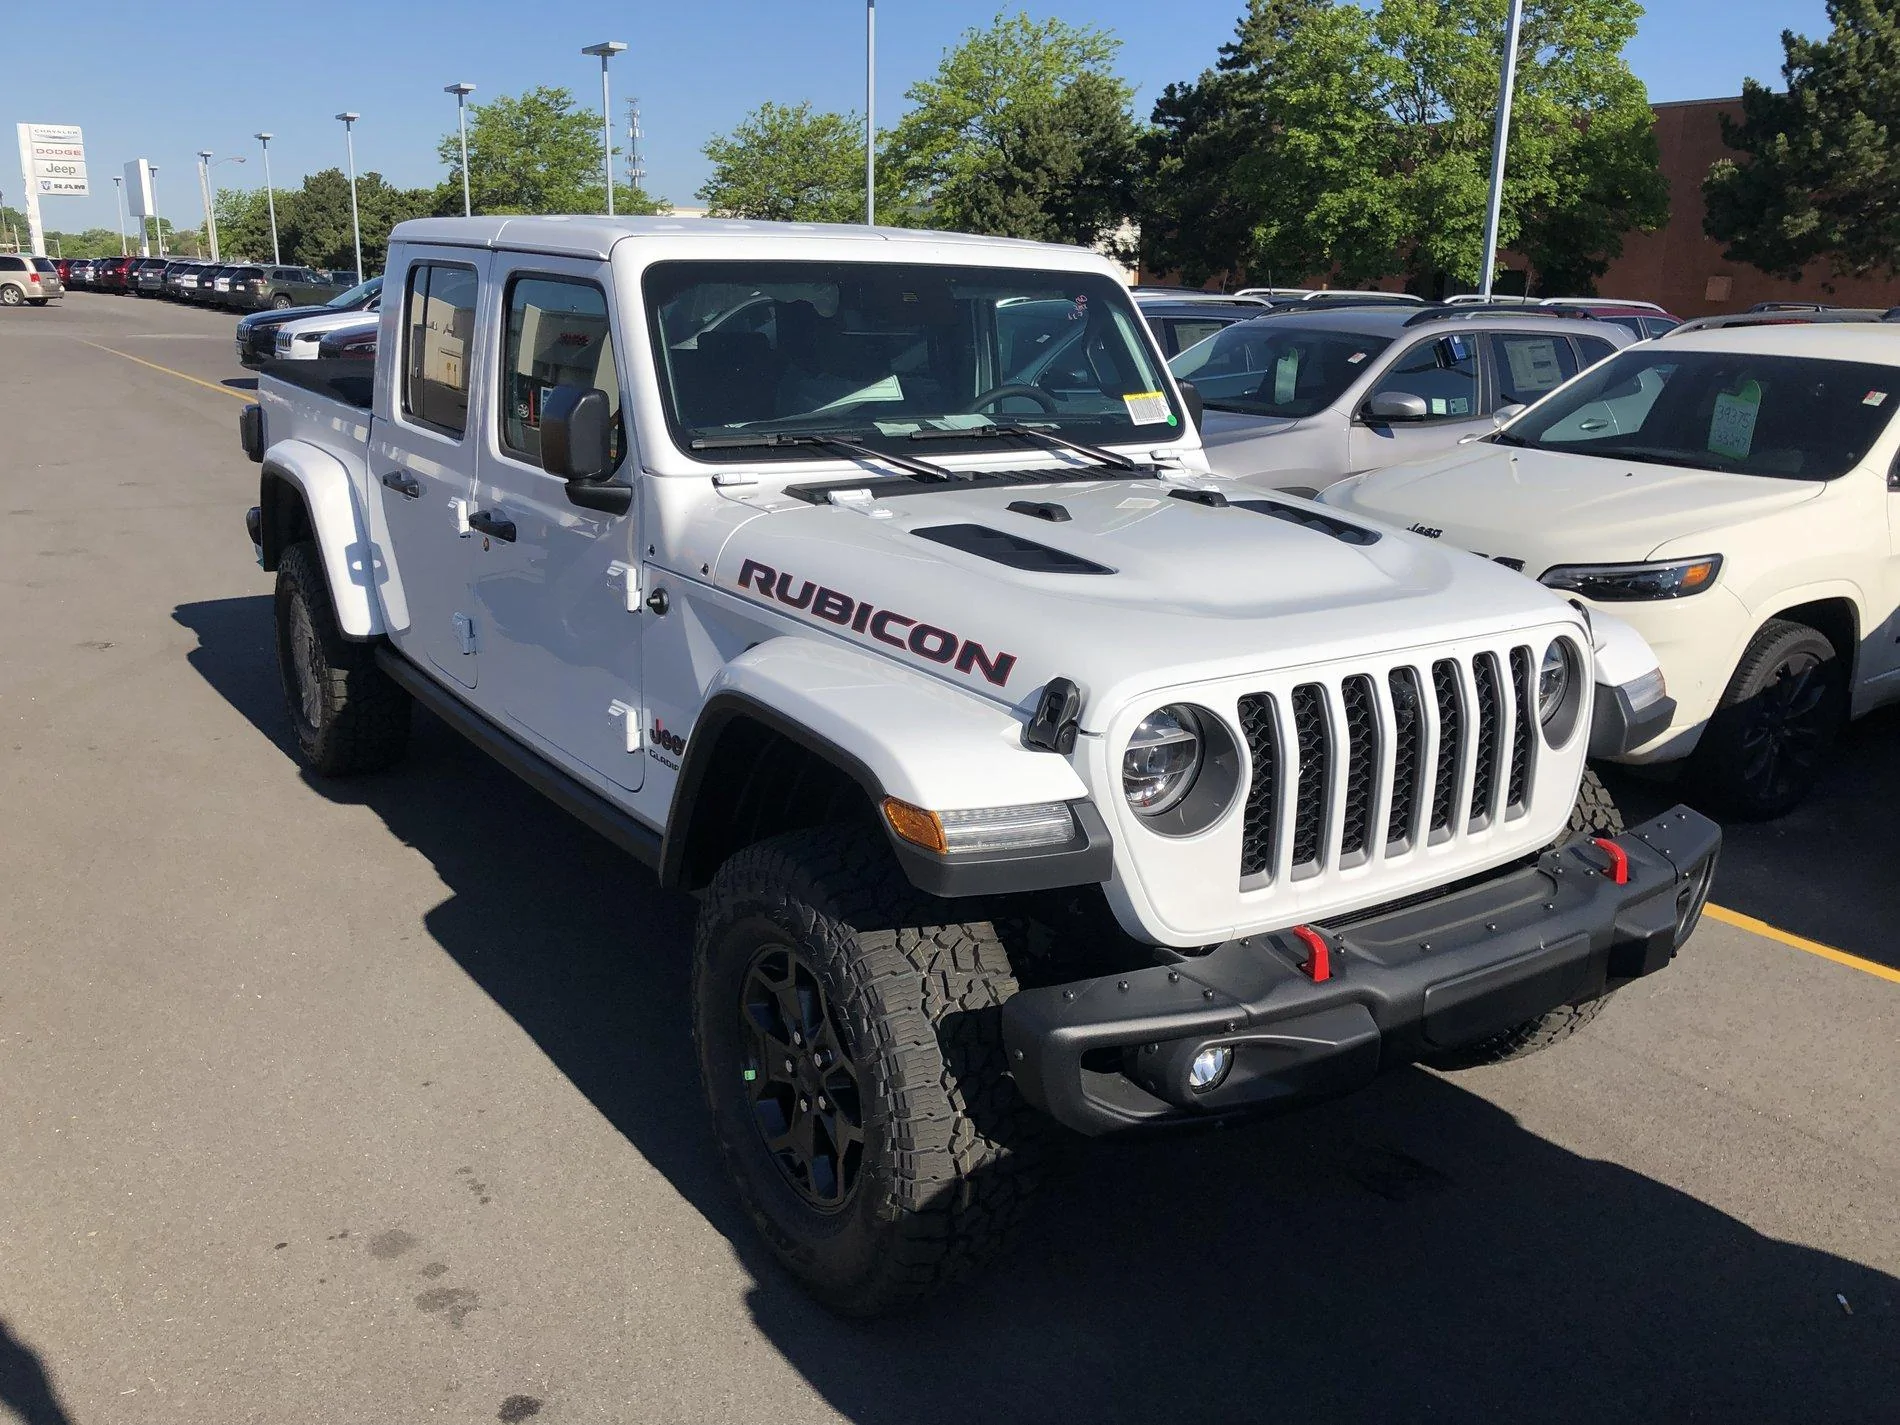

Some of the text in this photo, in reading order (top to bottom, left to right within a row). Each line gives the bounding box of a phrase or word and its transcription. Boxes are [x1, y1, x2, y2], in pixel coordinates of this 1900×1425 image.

[36, 148, 82, 156] DODGE
[46, 163, 76, 175] Jeep
[737, 558, 1018, 688] RUBICON
